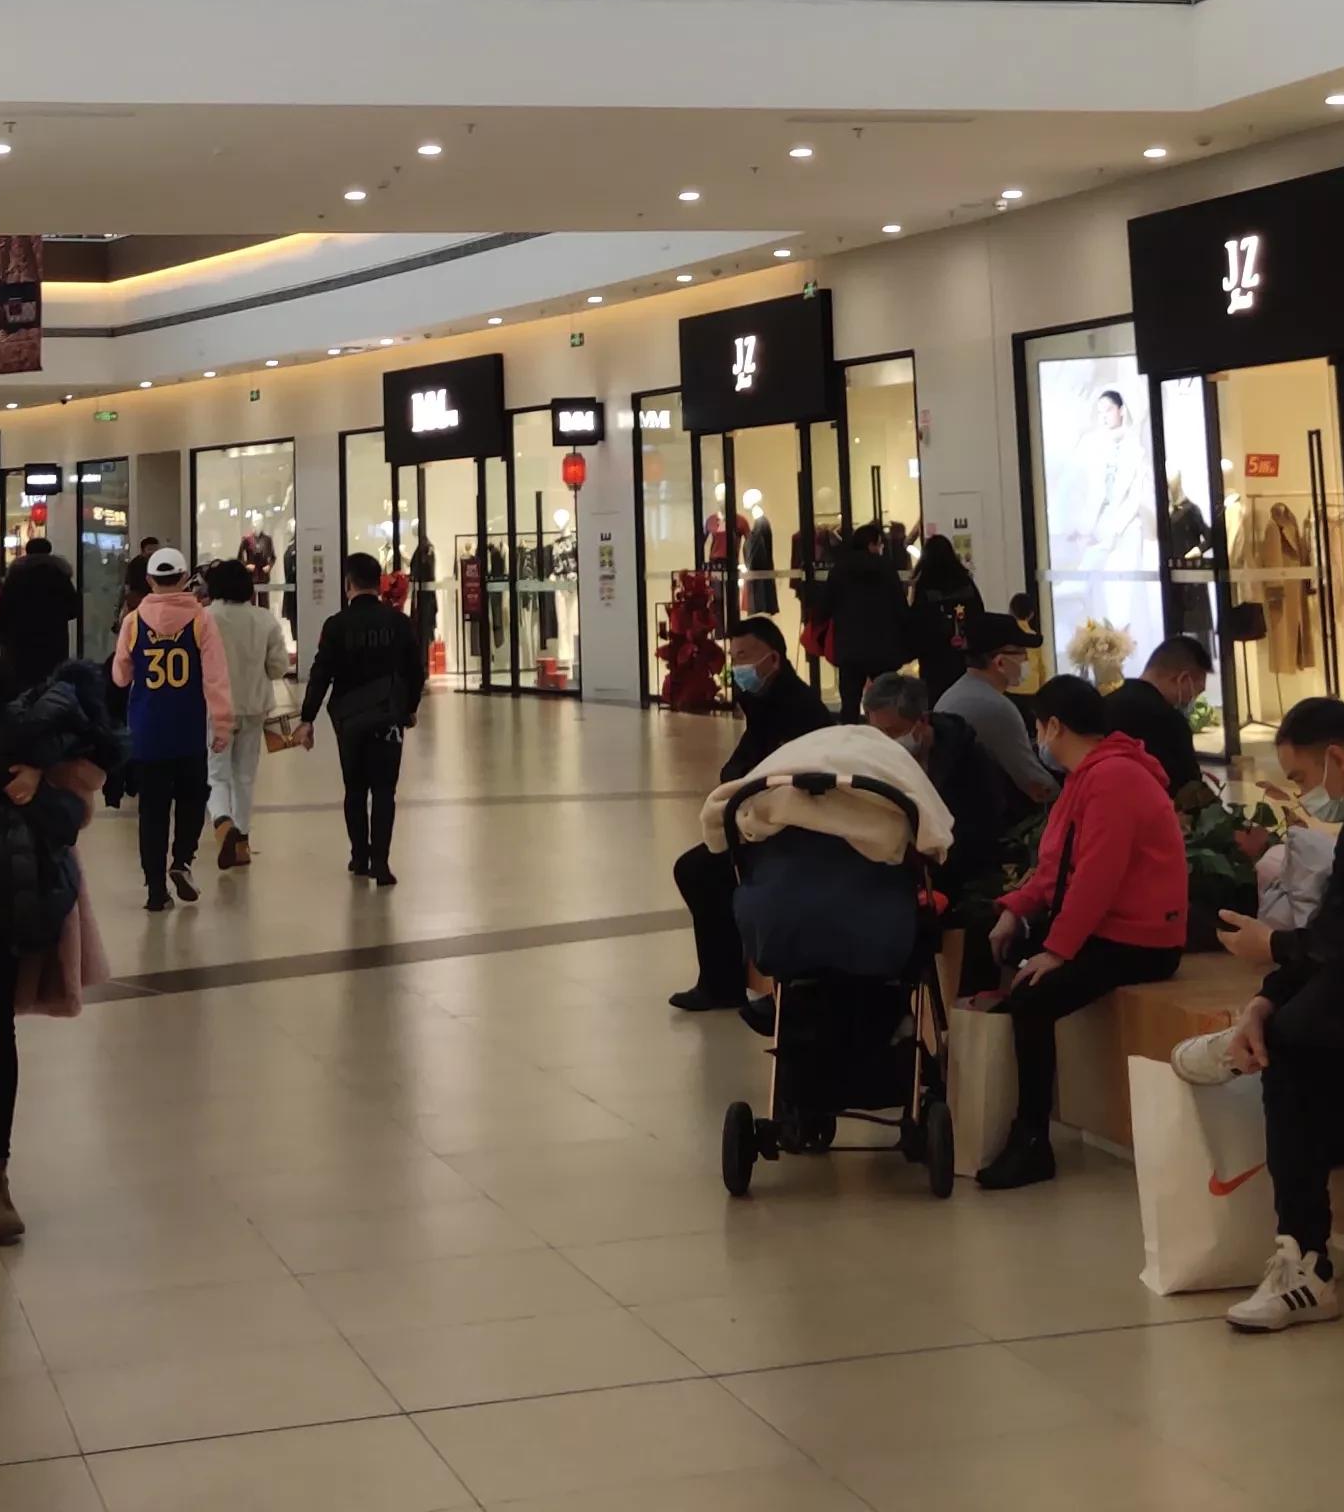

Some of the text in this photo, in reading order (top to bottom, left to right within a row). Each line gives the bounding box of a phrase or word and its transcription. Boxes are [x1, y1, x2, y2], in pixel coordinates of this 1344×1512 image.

[1222, 234, 1260, 292] JZ
[732, 335, 756, 375] JZ
[143, 647, 190, 690] 30
